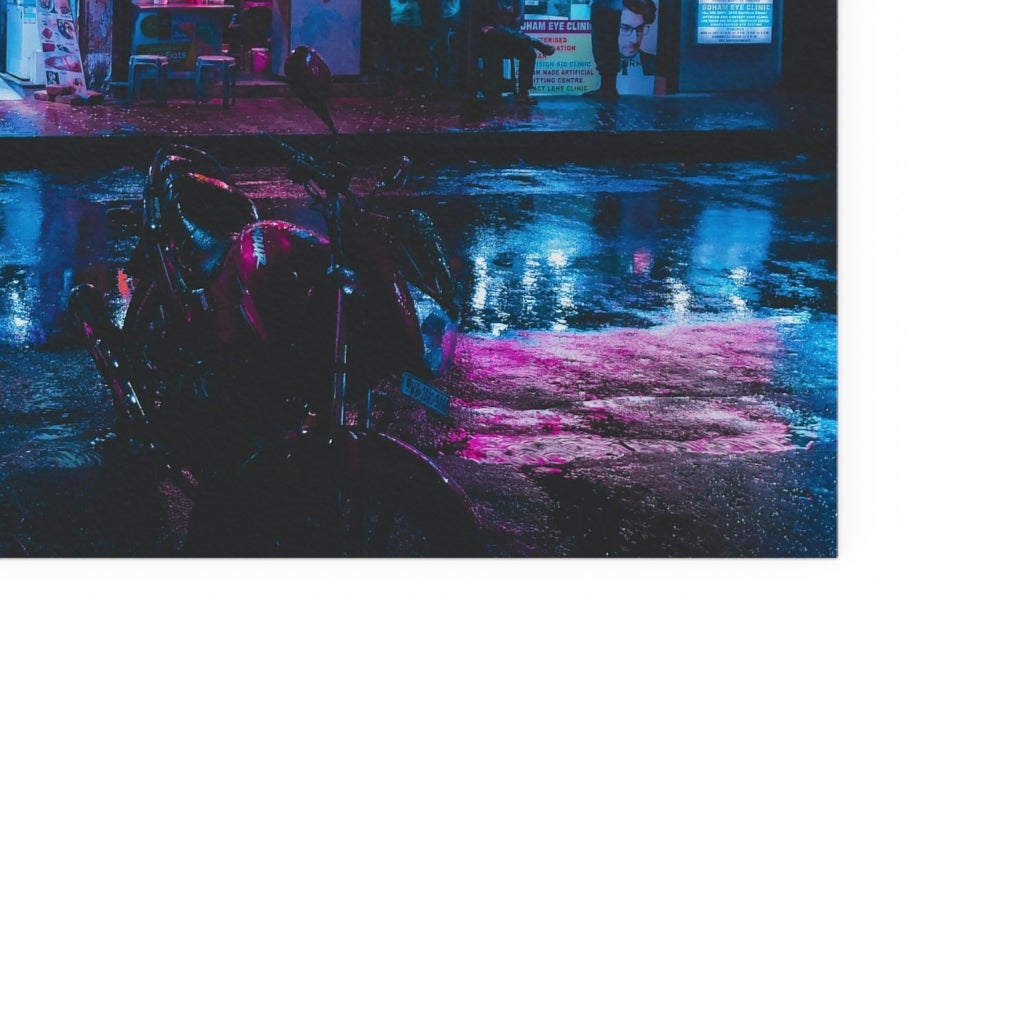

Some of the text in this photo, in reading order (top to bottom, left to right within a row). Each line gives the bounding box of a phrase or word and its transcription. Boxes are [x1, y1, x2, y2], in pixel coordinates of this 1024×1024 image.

[520, 22, 592, 31] OHAM EYE CLINI
